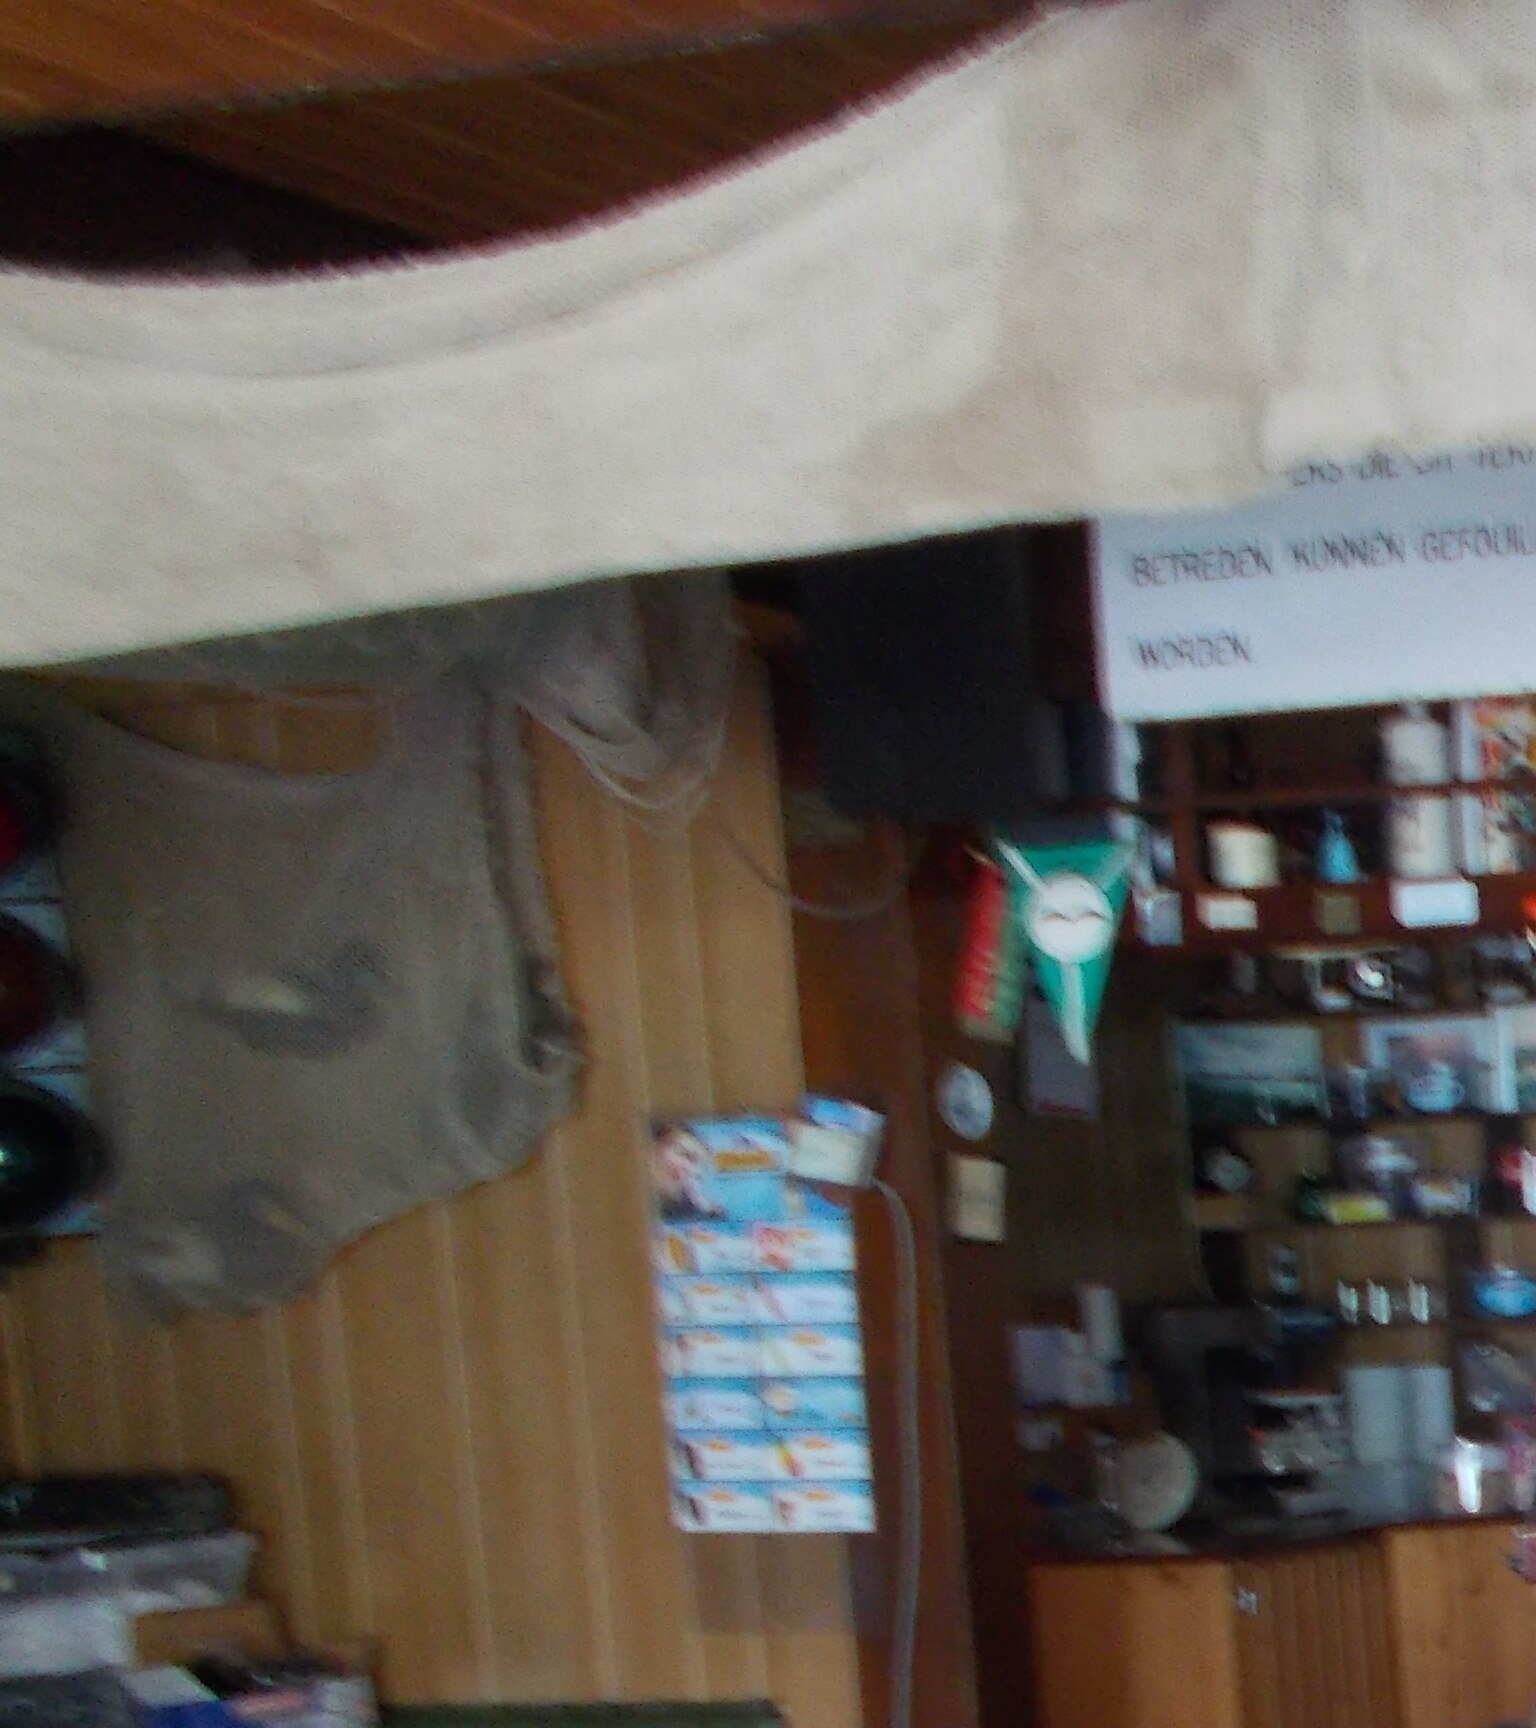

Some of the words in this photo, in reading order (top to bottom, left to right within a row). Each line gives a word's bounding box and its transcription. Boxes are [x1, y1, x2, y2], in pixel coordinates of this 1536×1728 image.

[1133, 541, 1272, 587] BETREDEN
[1291, 530, 1405, 572] KUNNEN
[1135, 631, 1251, 671] WORDEN
